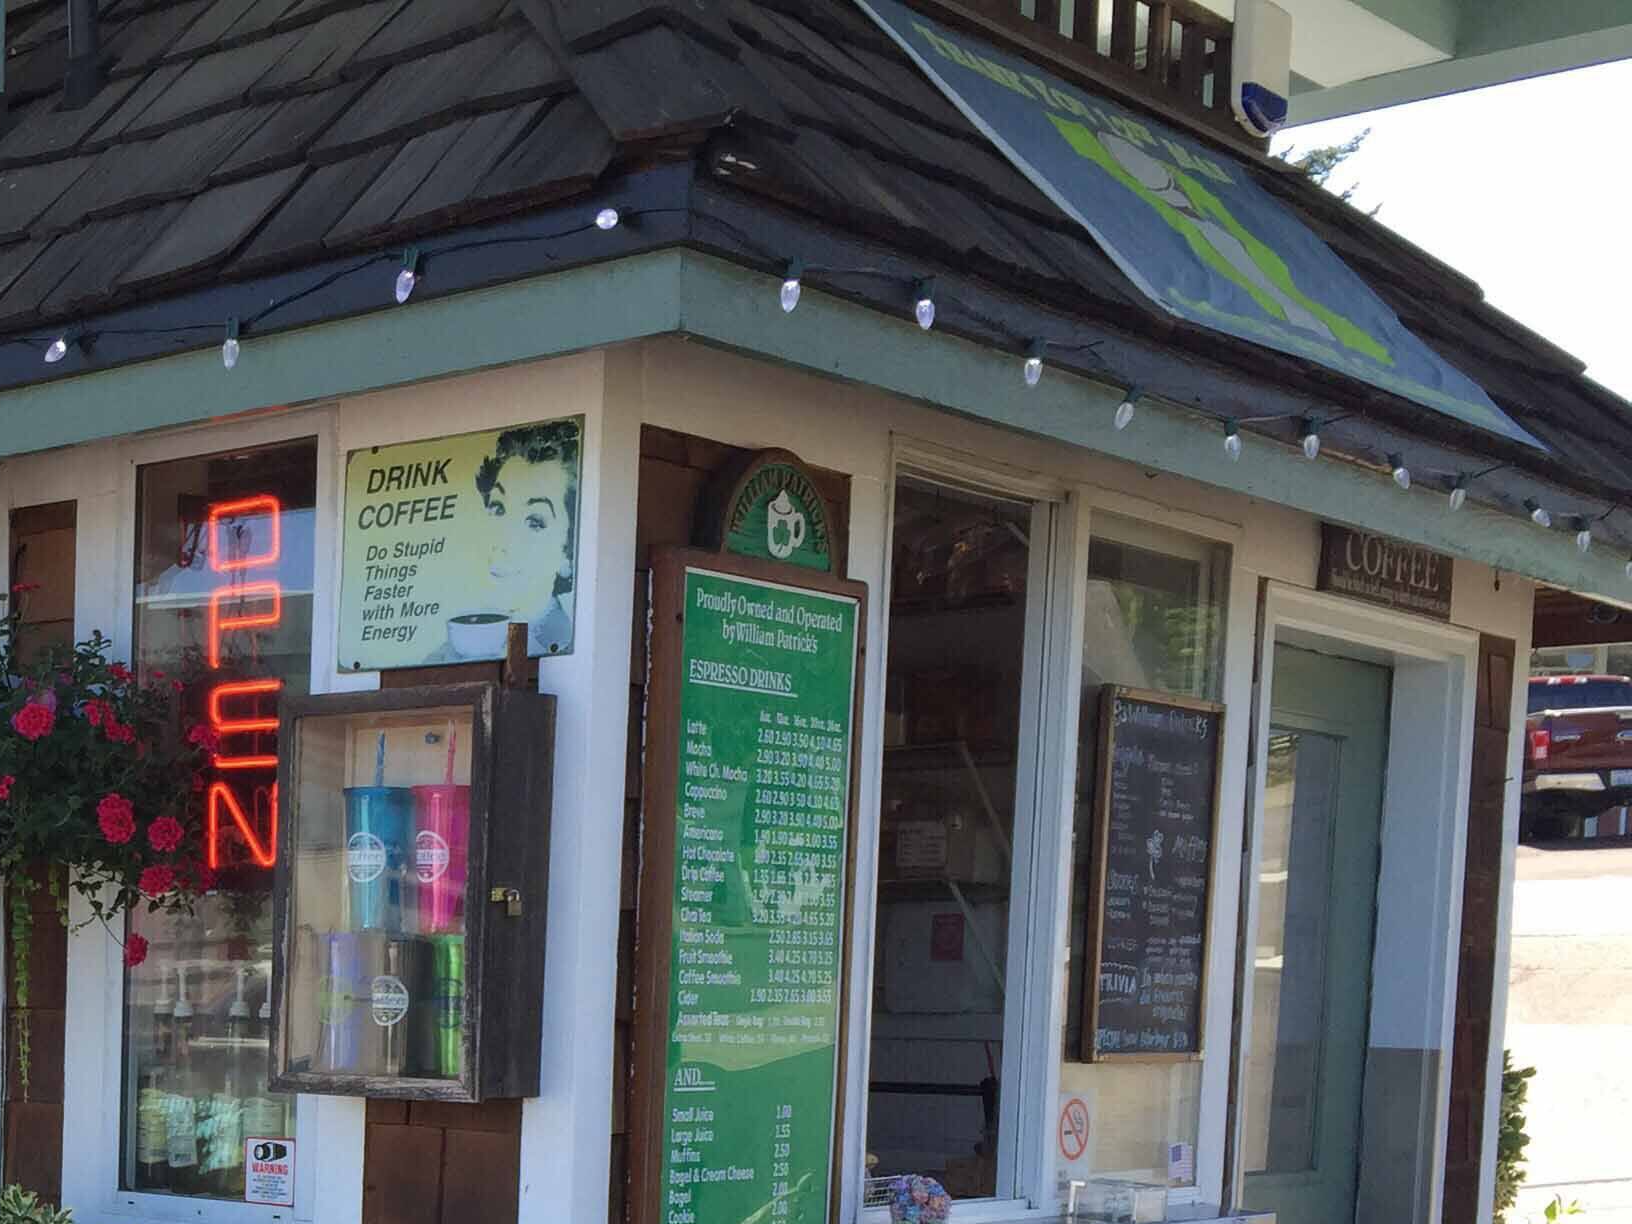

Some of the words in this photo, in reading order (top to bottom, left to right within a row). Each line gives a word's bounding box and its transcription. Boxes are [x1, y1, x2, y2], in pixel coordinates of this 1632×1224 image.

[366, 458, 452, 494] DRINK
[358, 495, 458, 530] COFFEE
[366, 545, 388, 561] Do
[393, 538, 445, 559] Stupid
[366, 564, 418, 582] Things
[364, 584, 414, 601] Faster
[362, 604, 395, 621] with
[400, 602, 440, 617] More
[696, 588, 736, 618] Proudly
[737, 595, 774, 620] Owned
[775, 605, 795, 625] and
[796, 607, 843, 633] Operated
[361, 624, 417, 642] Energy
[722, 619, 736, 645] by
[736, 622, 775, 647] William
[208, 493, 282, 870] OPEN
[689, 659, 748, 686] ESPRESSO
[749, 669, 792, 692] DRINKS
[678, 970, 704, 985] Coffee
[252, 1162, 288, 1176] WARNING
[701, 1166, 726, 1183] Cream
[727, 1165, 754, 1180] Cheese
